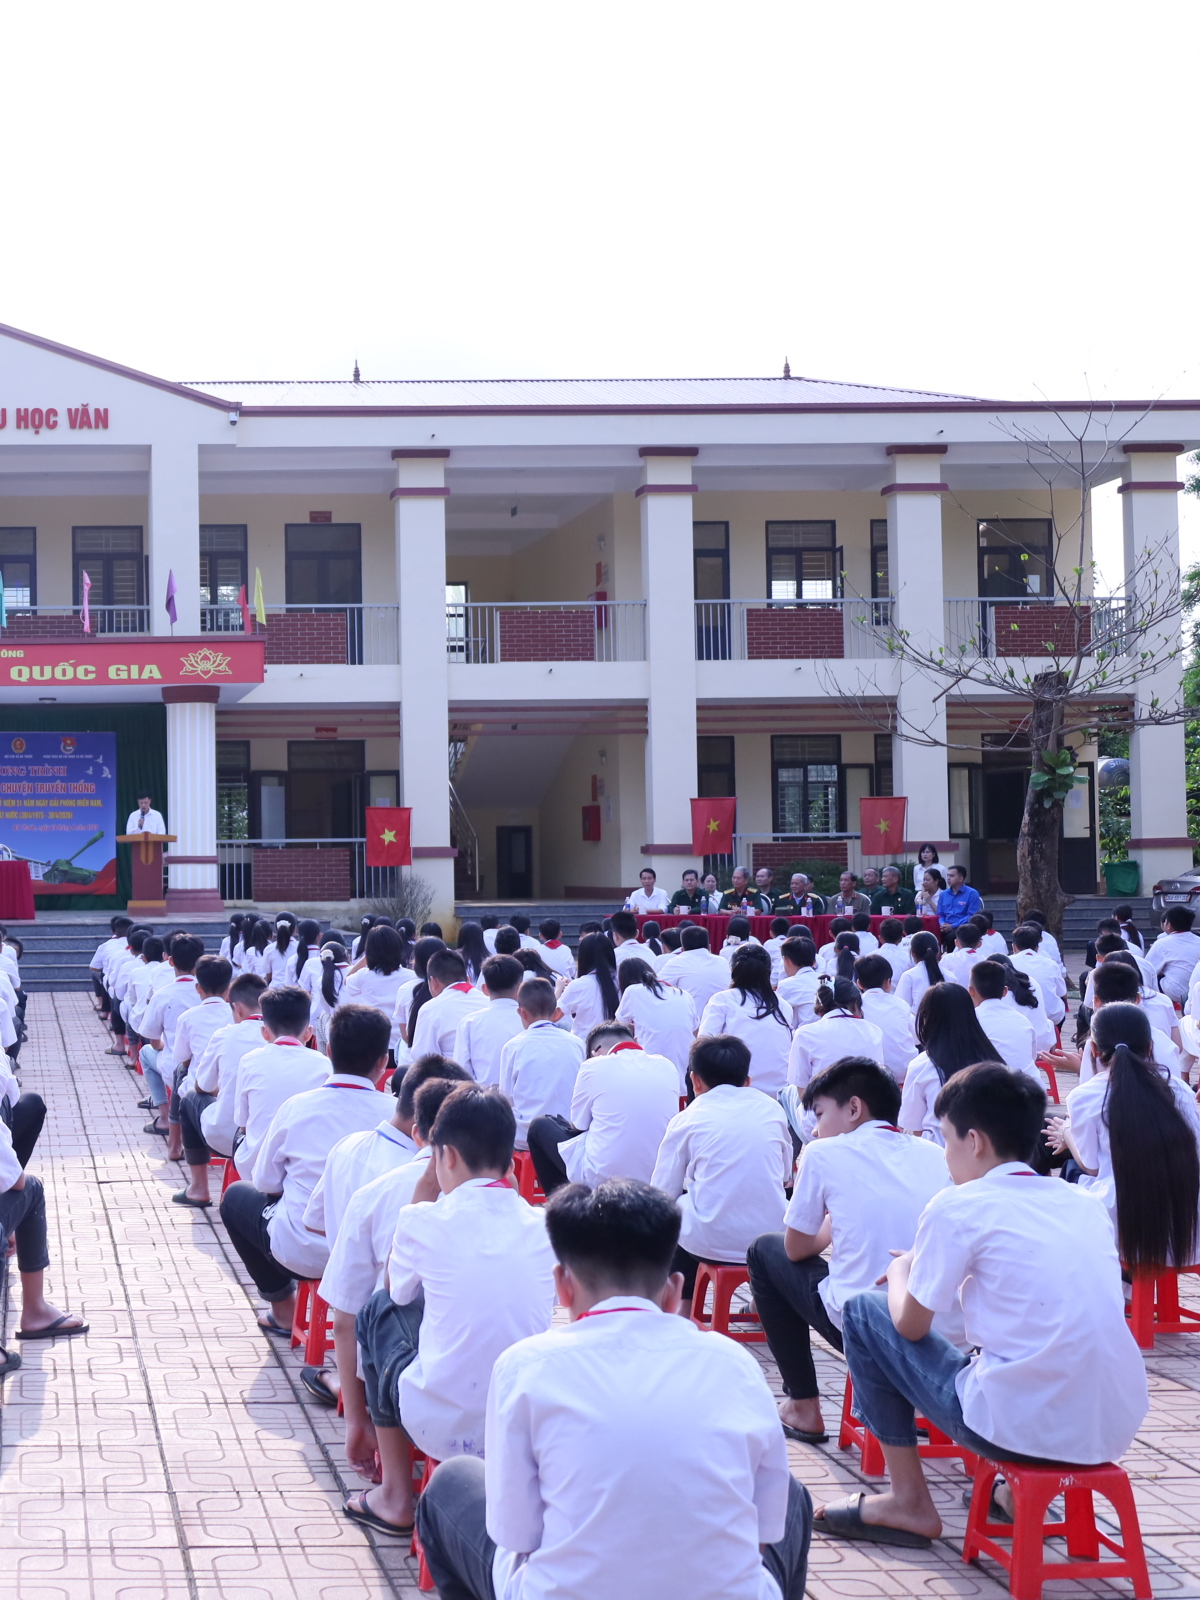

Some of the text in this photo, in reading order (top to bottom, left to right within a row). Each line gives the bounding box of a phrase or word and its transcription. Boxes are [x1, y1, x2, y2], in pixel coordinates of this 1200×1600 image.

[16, 407, 58, 435] HỌC
[66, 402, 109, 430] VĂN
[9, 660, 97, 683] QUỐC
[107, 664, 162, 680] GIA
[28, 763, 67, 776] TRÌNH
[1, 780, 34, 796] CHUYỆN
[35, 779, 66, 794] TRUYỀN
[68, 779, 96, 794] THỐNG
